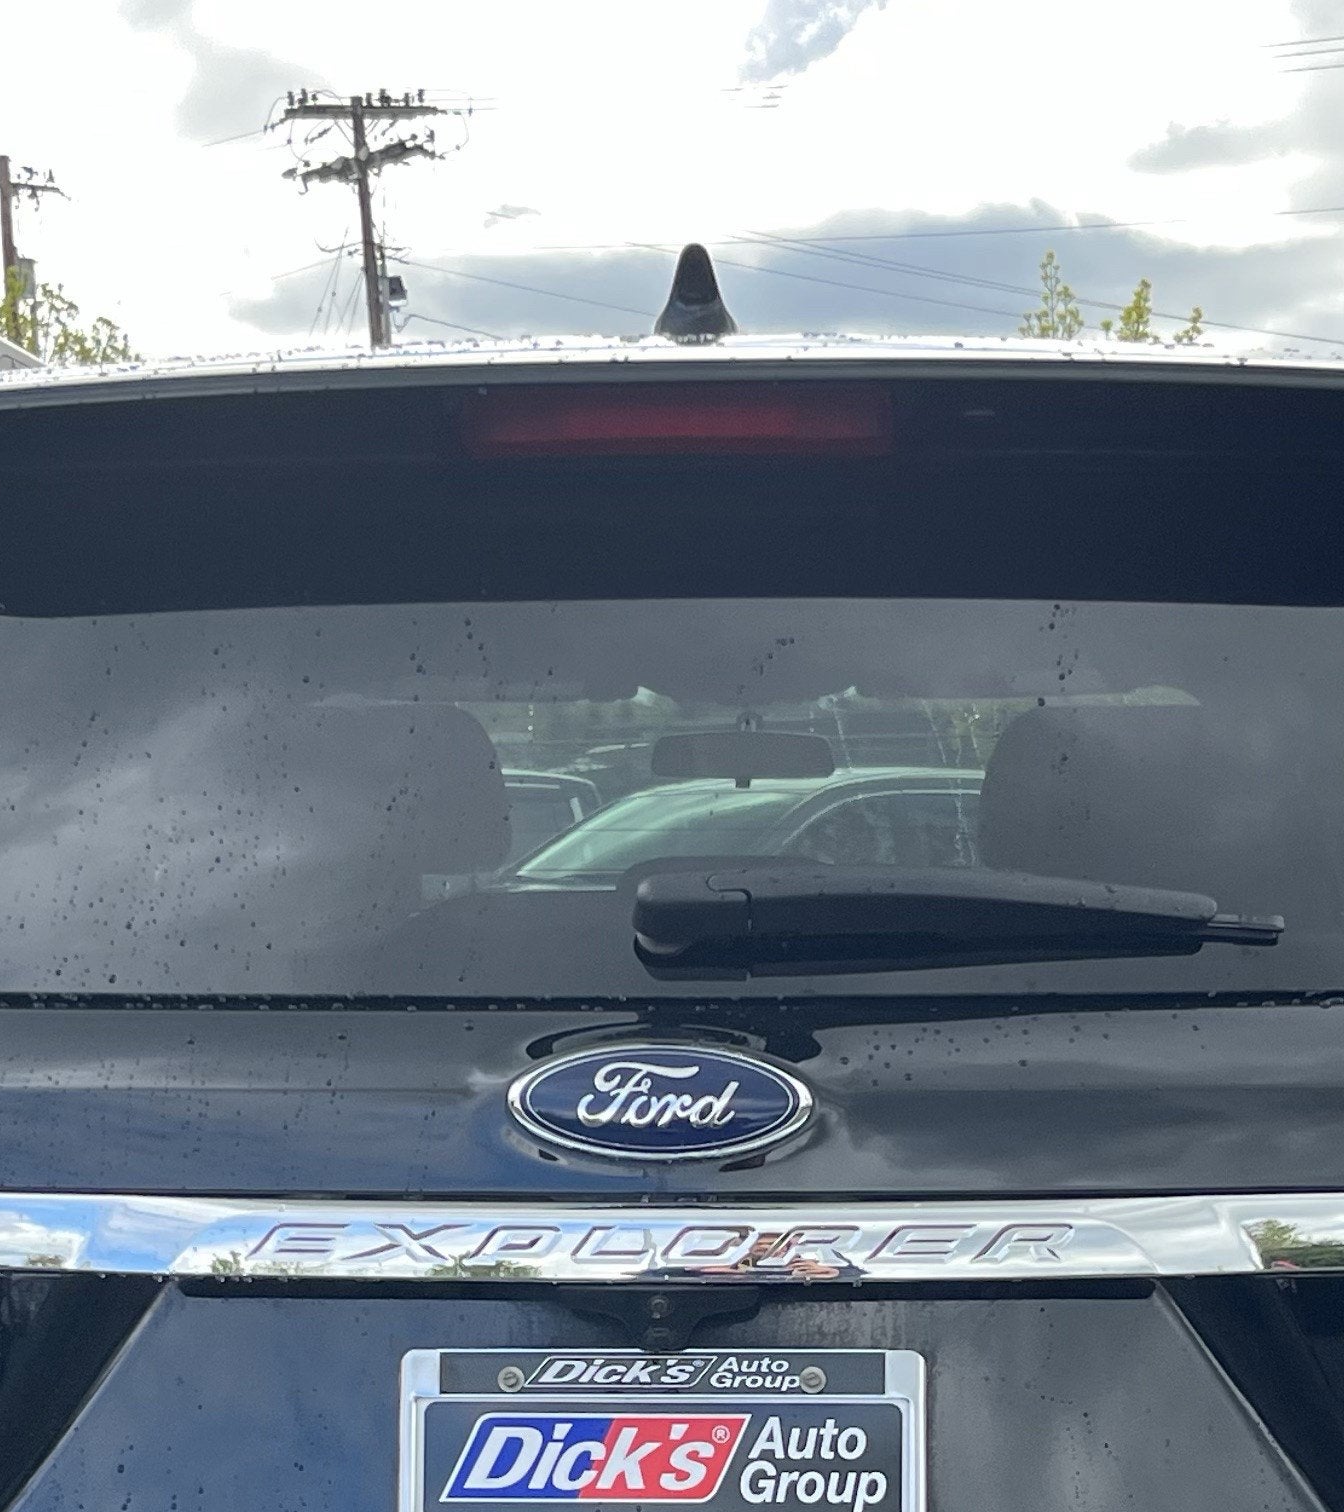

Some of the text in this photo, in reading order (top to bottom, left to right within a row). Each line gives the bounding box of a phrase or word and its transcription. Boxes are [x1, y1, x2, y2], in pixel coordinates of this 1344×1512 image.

[578, 1061, 740, 1130] Ford
[246, 1222, 1076, 1268] EXPLORER
[537, 1359, 695, 1384] Dick's
[709, 1373, 800, 1391] Group
[716, 1356, 790, 1373] Auto
[462, 1422, 716, 1493] Dick's
[748, 1417, 868, 1461] Auto
